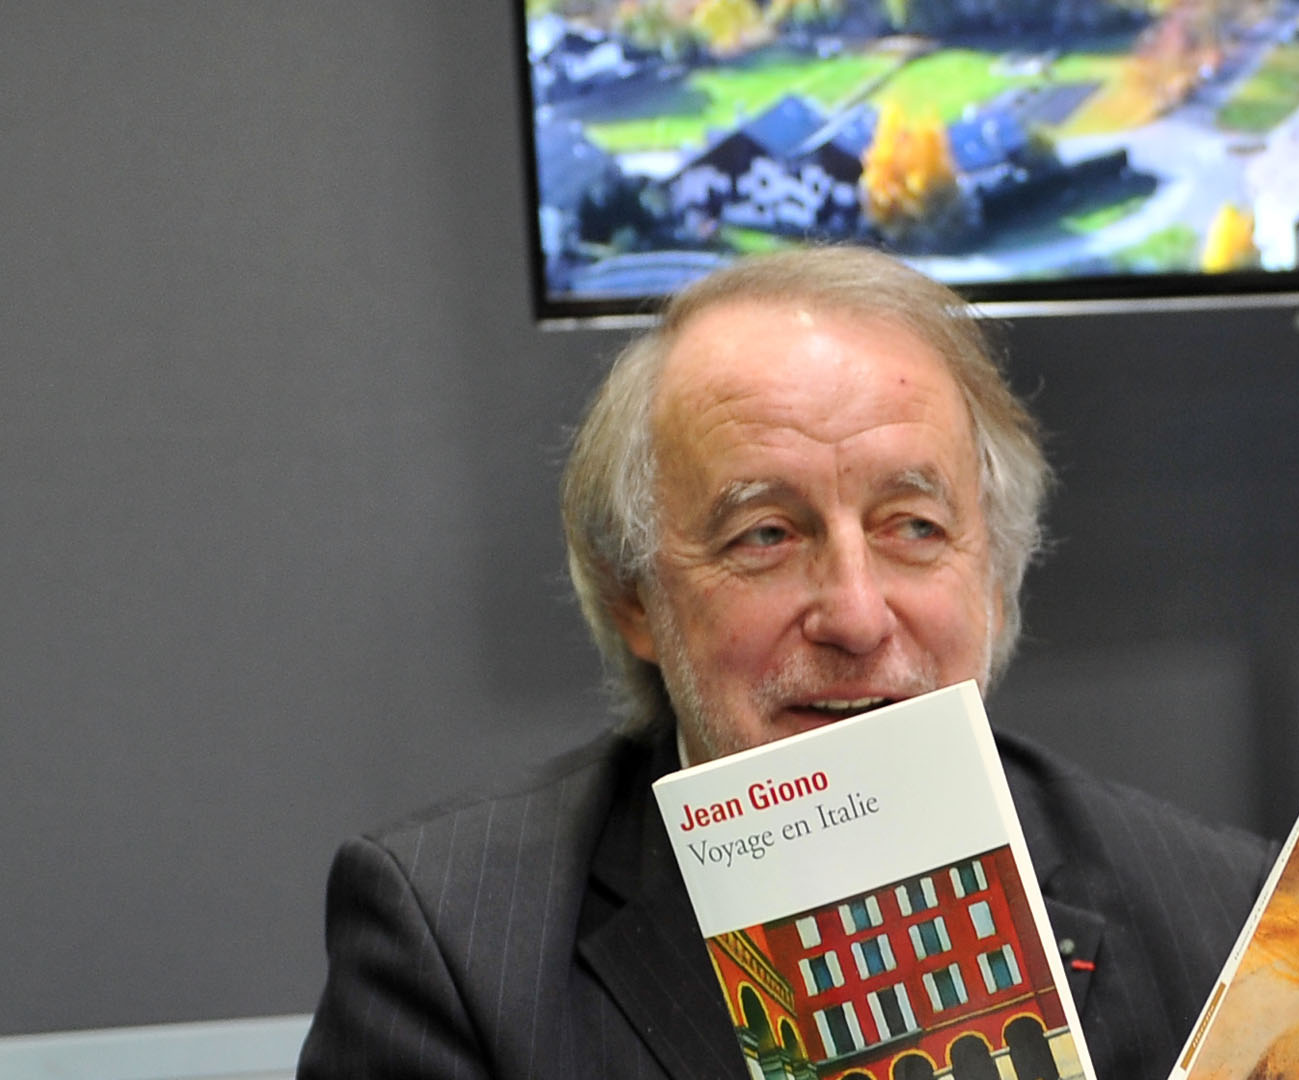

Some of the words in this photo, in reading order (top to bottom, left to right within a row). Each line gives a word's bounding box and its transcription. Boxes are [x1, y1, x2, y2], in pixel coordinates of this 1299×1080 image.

[680, 794, 744, 832] Jean
[747, 769, 829, 811] Giono
[687, 830, 775, 868] Voyage
[781, 818, 812, 840] en
[815, 791, 880, 830] Italie
